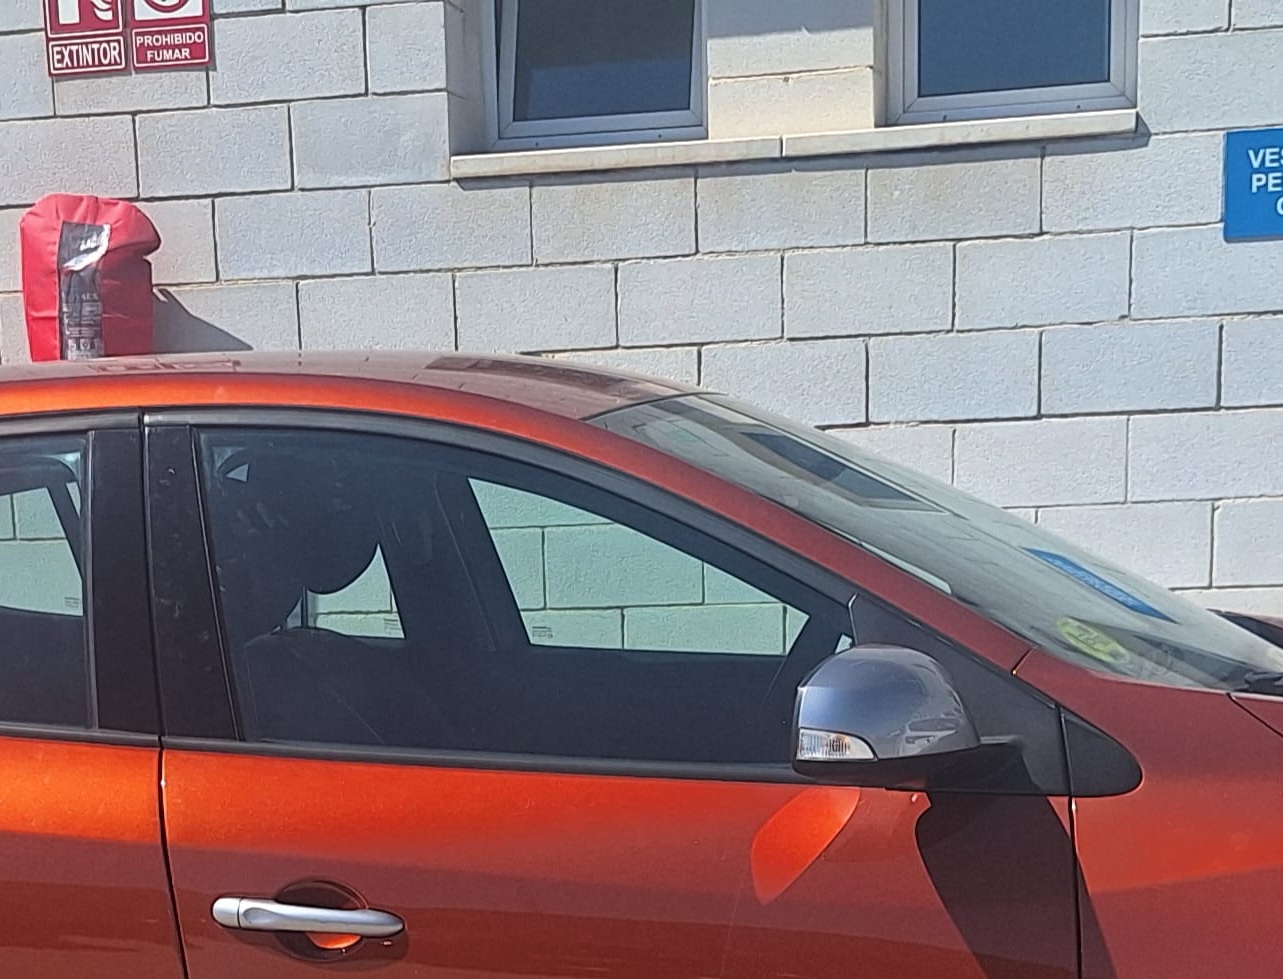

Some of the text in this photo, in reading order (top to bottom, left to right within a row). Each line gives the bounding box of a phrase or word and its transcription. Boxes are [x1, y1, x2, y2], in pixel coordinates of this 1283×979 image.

[136, 31, 204, 47] PROHIBIDO
[53, 42, 120, 68] EXTINTOR
[147, 48, 190, 62] FUMAR
